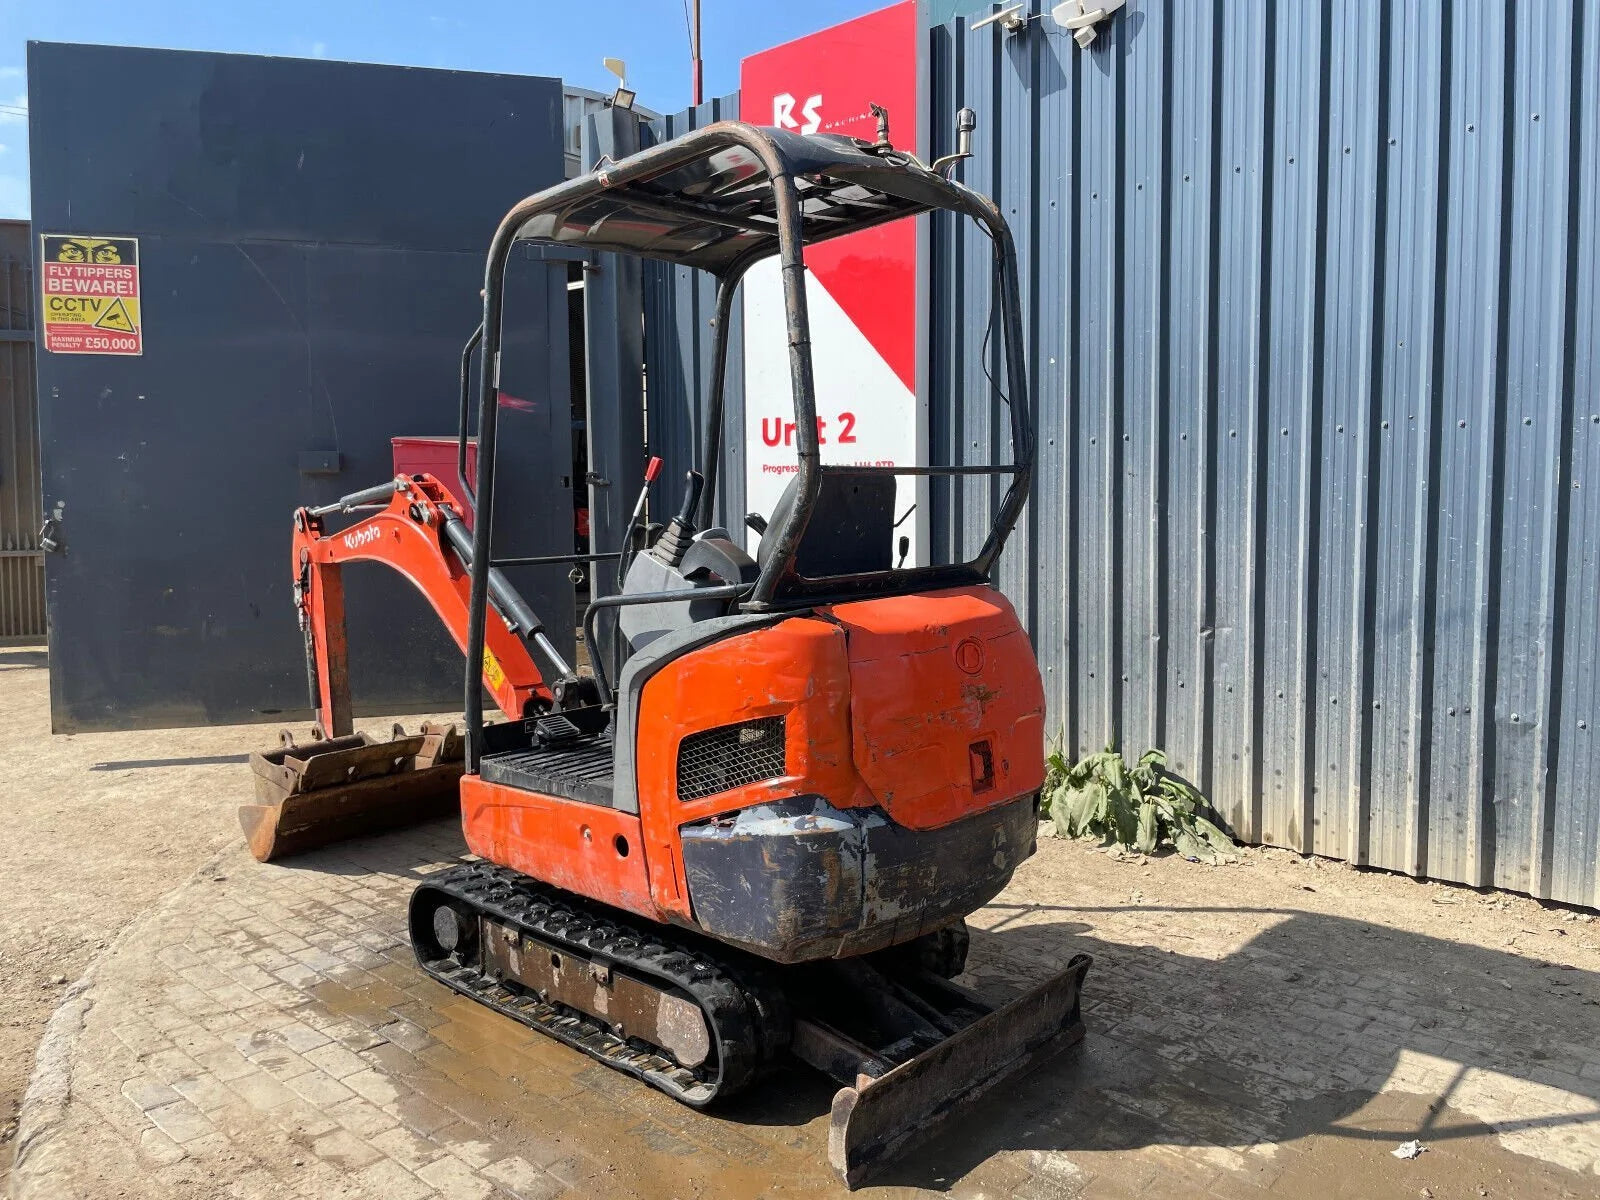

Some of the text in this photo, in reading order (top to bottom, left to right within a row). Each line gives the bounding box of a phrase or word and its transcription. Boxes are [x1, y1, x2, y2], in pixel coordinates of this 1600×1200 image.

[773, 93, 823, 136] RS
[49, 266, 132, 278] FLY TIPPERS
[48, 278, 134, 294] BEWARE!
[50, 297, 102, 312] CCTV
[85, 337, 136, 350] £50,000
[762, 412, 857, 447] Unt 2
[343, 524, 381, 549] Kubota
